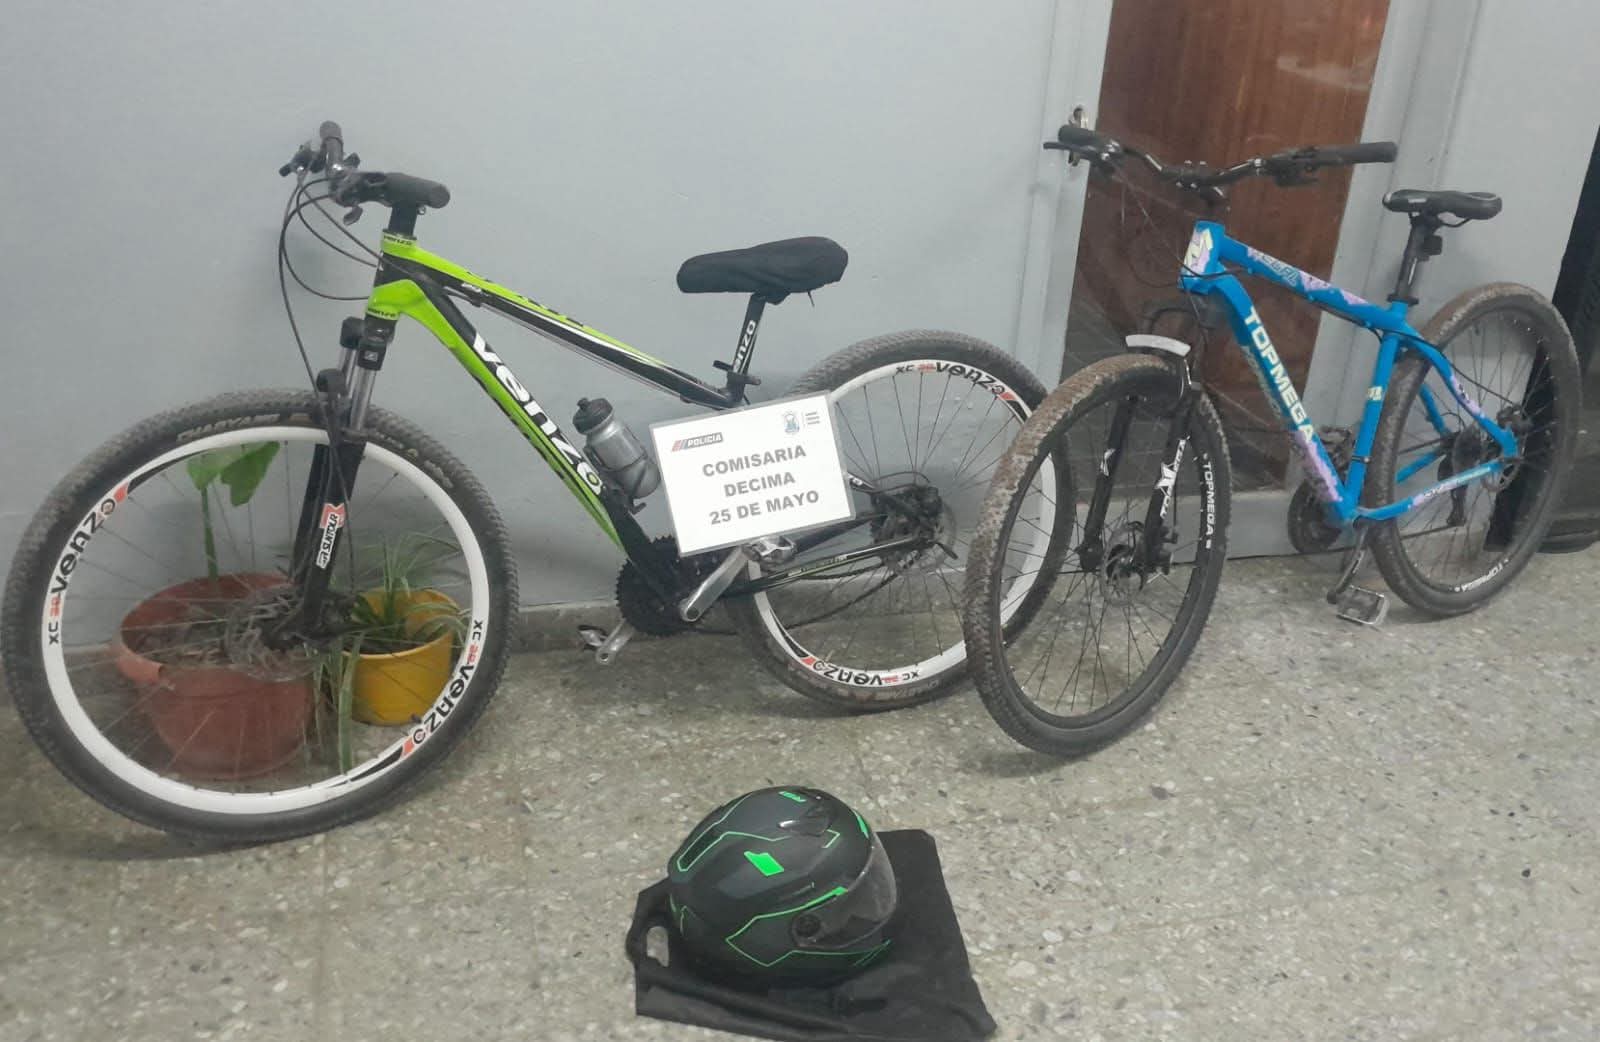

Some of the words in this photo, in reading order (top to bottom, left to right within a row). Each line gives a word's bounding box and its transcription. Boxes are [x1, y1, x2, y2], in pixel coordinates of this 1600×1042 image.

[1244, 306, 1314, 442] TOPMEGA
[687, 433, 723, 448] POLICIA
[702, 445, 808, 477] COMISARIA
[723, 472, 797, 497] DECIMA
[1203, 461, 1216, 536] TOPMEGA
[709, 509, 732, 525] 25
[736, 502, 762, 520] DE
[766, 490, 821, 514] MAYO
